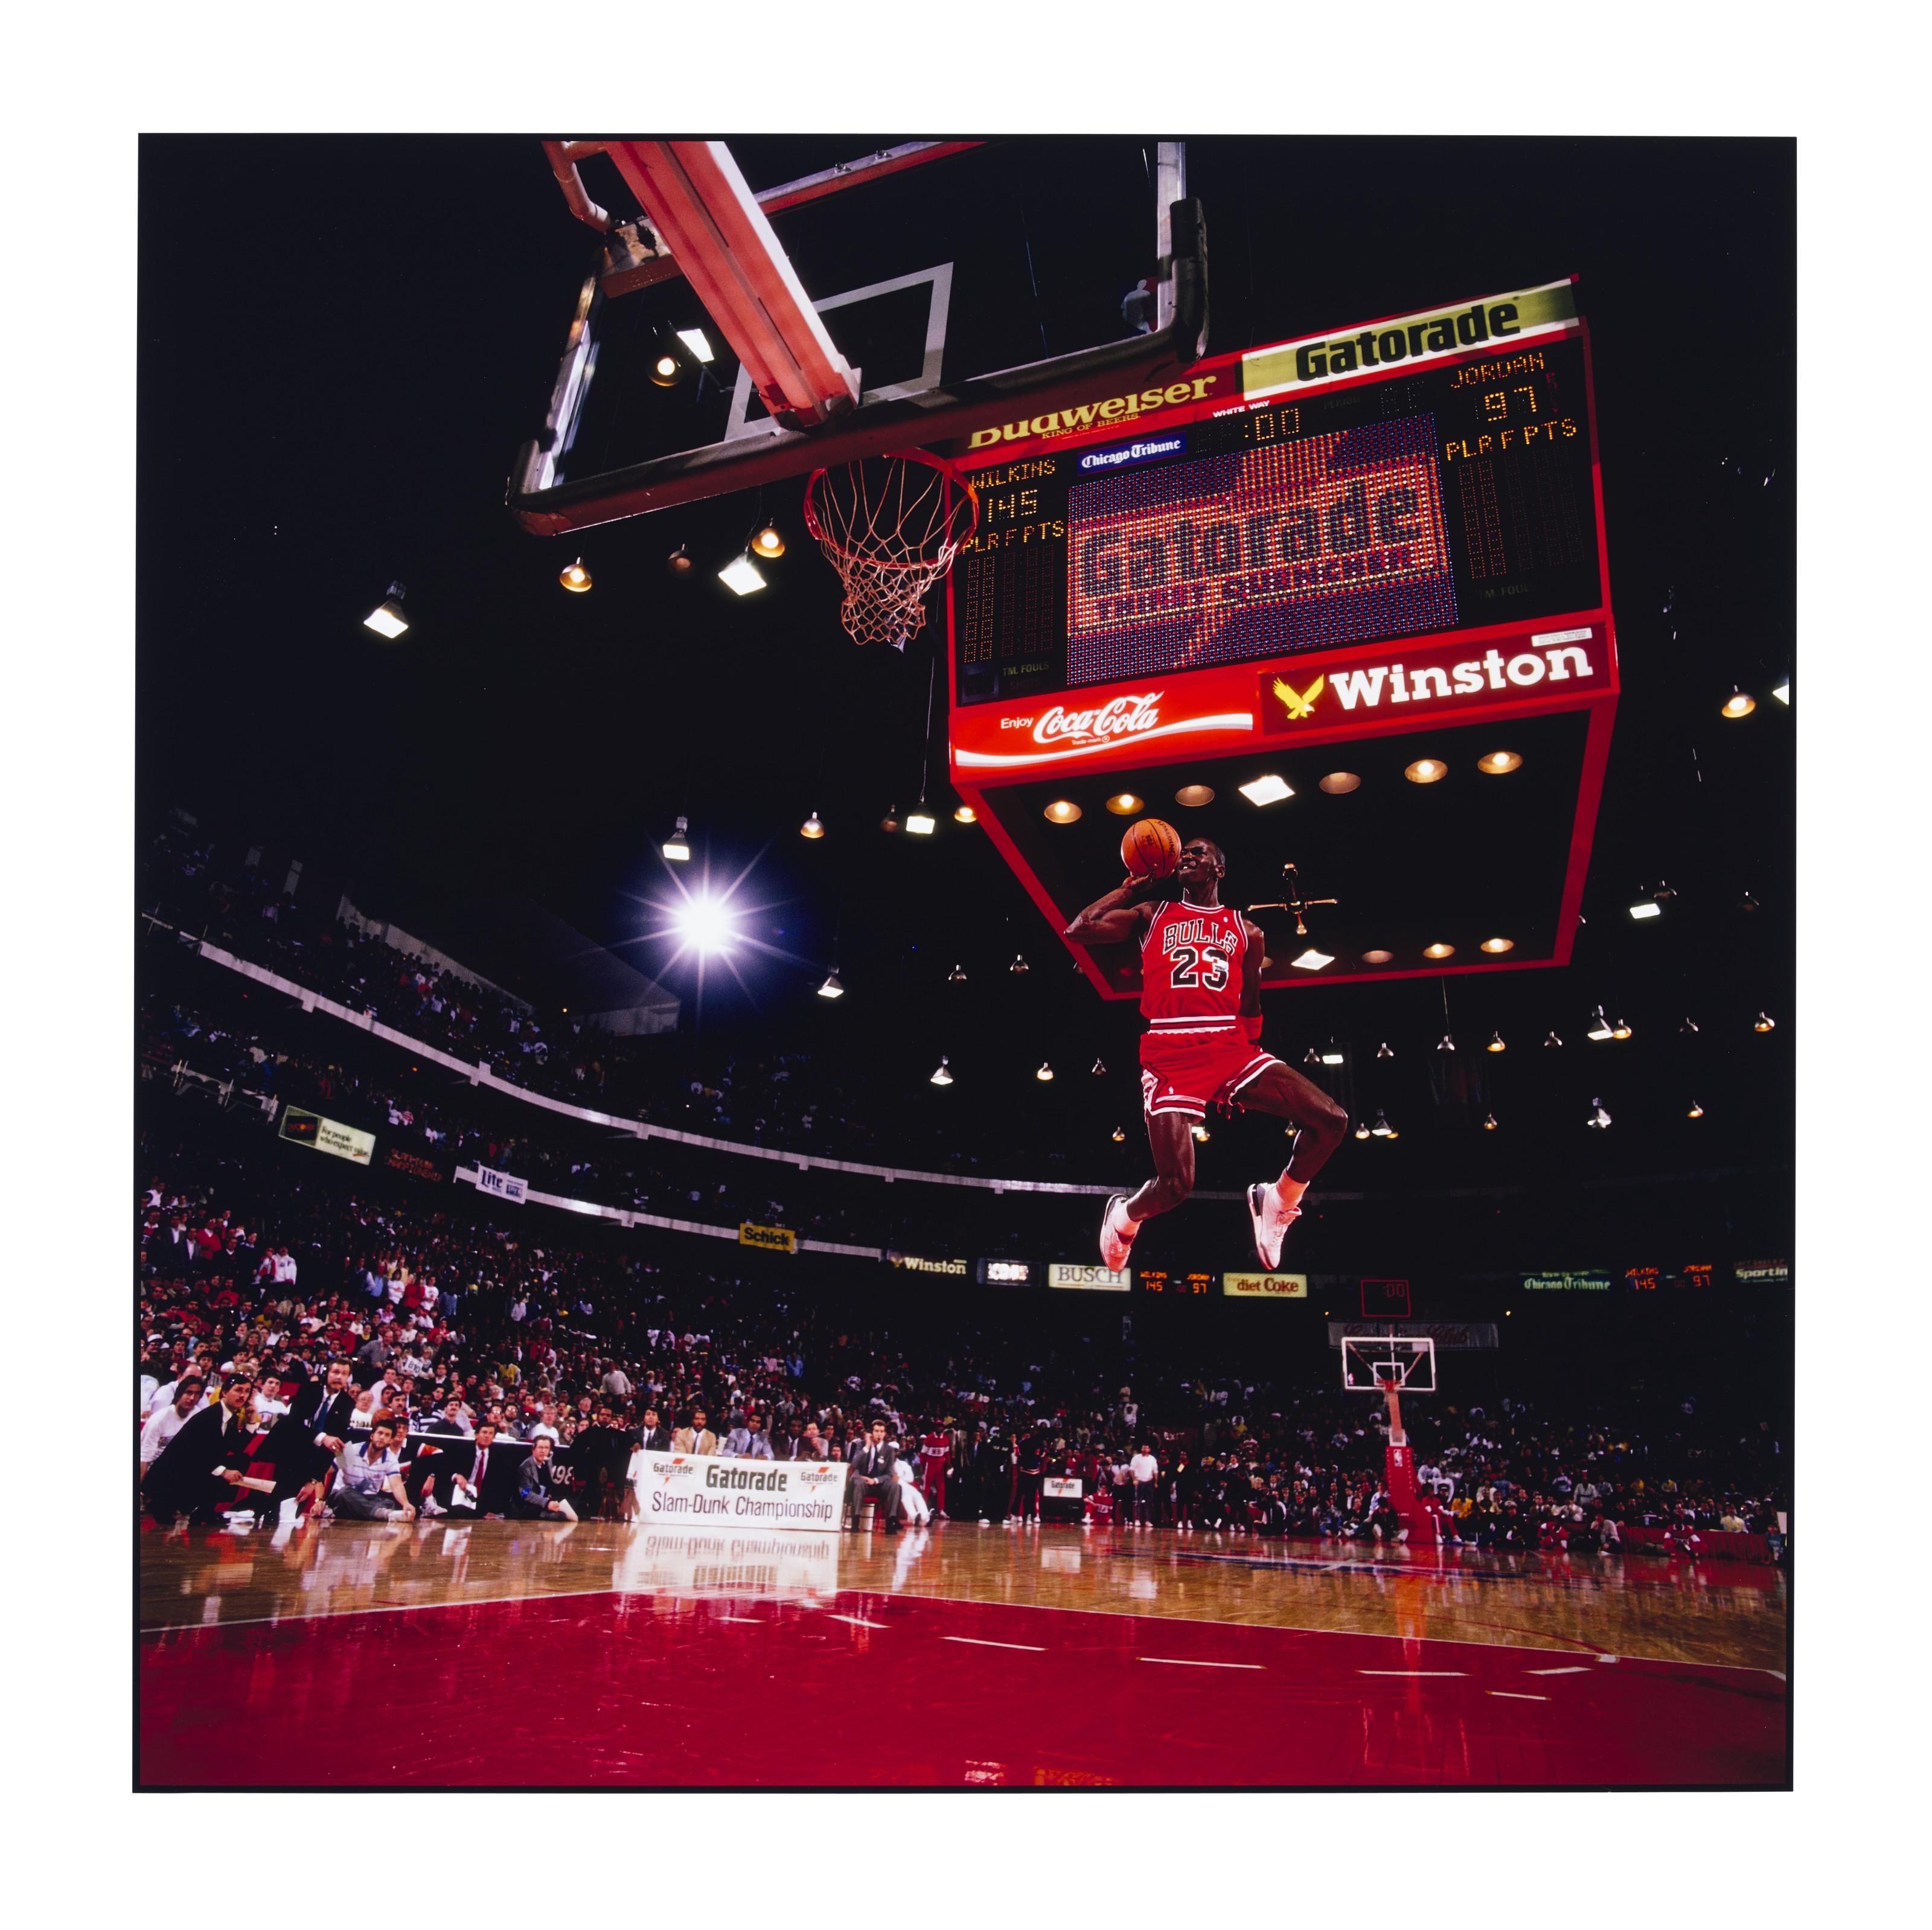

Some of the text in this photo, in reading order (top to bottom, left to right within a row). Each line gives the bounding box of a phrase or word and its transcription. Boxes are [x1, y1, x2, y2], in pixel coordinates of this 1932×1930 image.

[1296, 302, 1521, 382] Gatorade
[1450, 352, 1544, 389] JORDAN
[1213, 400, 1270, 418] WHITE WAY
[1484, 386, 1537, 421] 97
[1041, 427, 1073, 439] KING
[1445, 418, 1578, 461] PLR F PTS
[1081, 439, 1182, 468] Chicago Tribune
[971, 459, 1057, 491] WILKINS
[988, 489, 1038, 523] 145
[1005, 528, 1018, 547] F
[1023, 519, 1065, 544] PTS
[1080, 479, 1422, 598] Gatorade
[1020, 661, 1050, 674] FOULS
[1329, 644, 1593, 711] Winston
[1000, 690, 1165, 744] Enjoy Coca-Cola
[1162, 918, 1238, 956] BULLS
[1169, 945, 1229, 992] 23
[321, 1126, 352, 1142] For people
[320, 1136, 331, 1145] who
[332, 1139, 353, 1152] expect
[481, 1168, 503, 1189] Lite
[744, 1227, 790, 1246] Schick
[905, 1257, 967, 1275] Winston
[1058, 1266, 1123, 1284] BUSCH
[1146, 1280, 1163, 1293] 145
[1192, 1282, 1206, 1294] 97
[1237, 1277, 1299, 1293] diet Coke
[1564, 1276, 1611, 1291] Tribune
[1634, 1277, 1657, 1291] 145
[1692, 1274, 1711, 1288] 97
[653, 1462, 694, 1475] Gatorade
[706, 1464, 788, 1492] Gatorade
[801, 1471, 838, 1483] Gatorade
[1051, 1480, 1075, 1489] Gatorade
[652, 1491, 833, 1523] Slam-Dunk Championship
